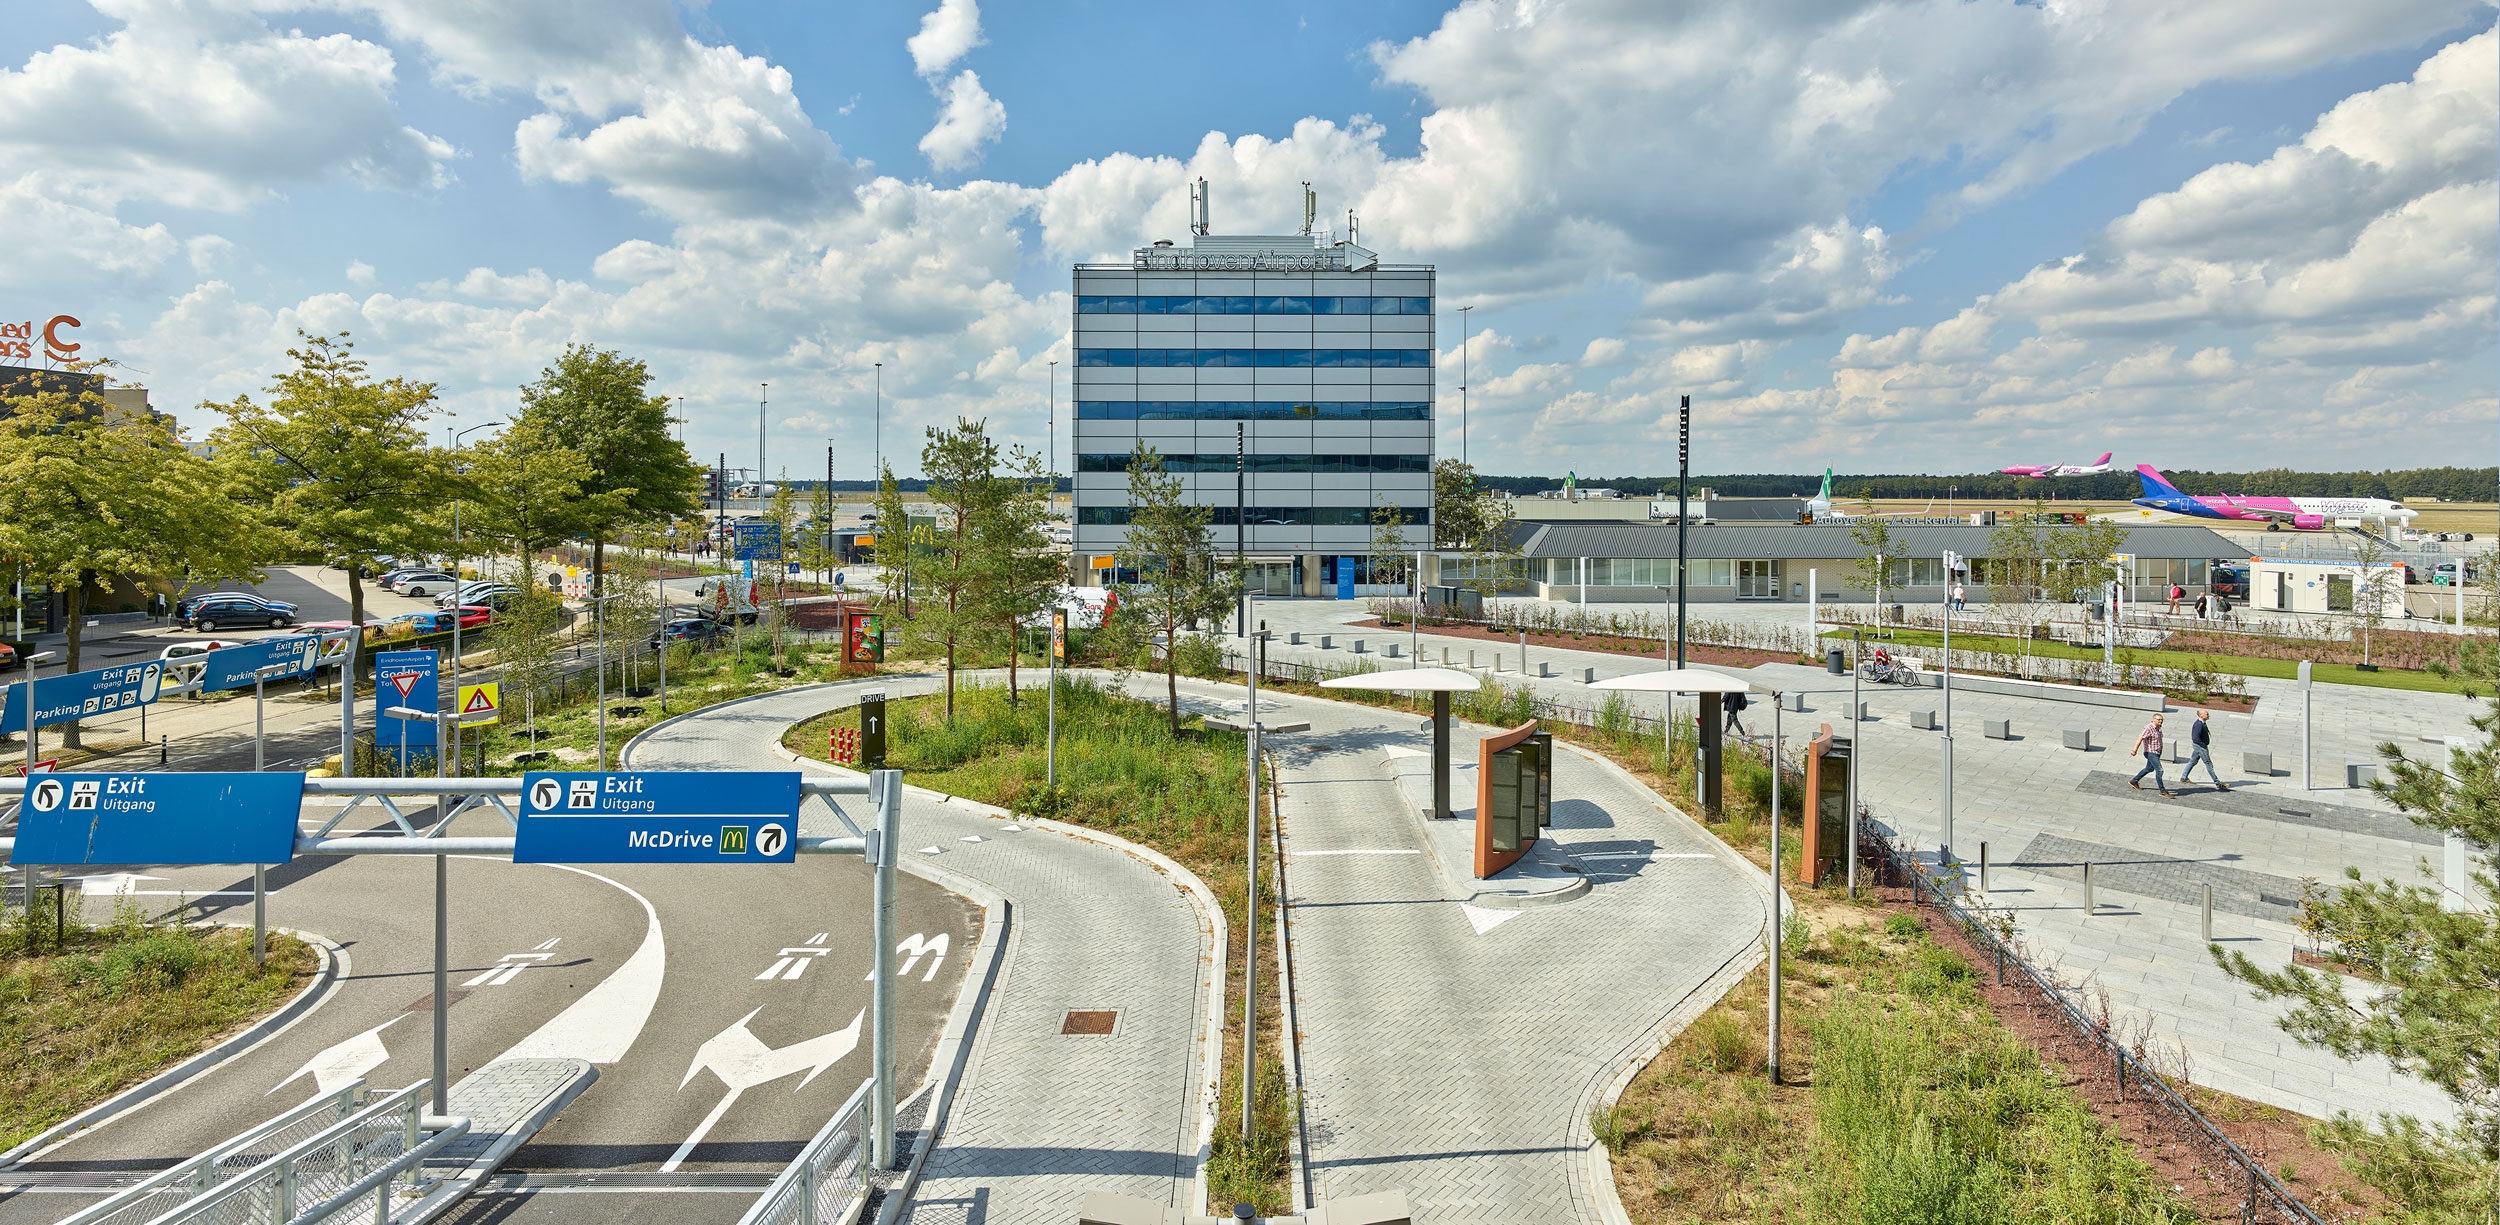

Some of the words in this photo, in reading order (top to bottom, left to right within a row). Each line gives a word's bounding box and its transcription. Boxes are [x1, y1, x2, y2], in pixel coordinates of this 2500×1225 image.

[1133, 249, 1327, 275] EindhovenAirport
[0, 320, 32, 339] ed
[1901, 515, 1920, 525] Car
[1923, 515, 1961, 525] Rental
[275, 641, 292, 651] Exit
[268, 651, 290, 659] Uitgang
[102, 668, 124, 681] Exit
[226, 670, 258, 683] Parking
[93, 680, 122, 691] Uitgang
[861, 693, 885, 704] DRIVE
[34, 704, 81, 720] Parking
[106, 776, 146, 794] Exit
[604, 775, 644, 793] Exit
[103, 798, 156, 813] Uitgang
[602, 797, 655, 812] Uitgang
[628, 829, 714, 848] McDrive
